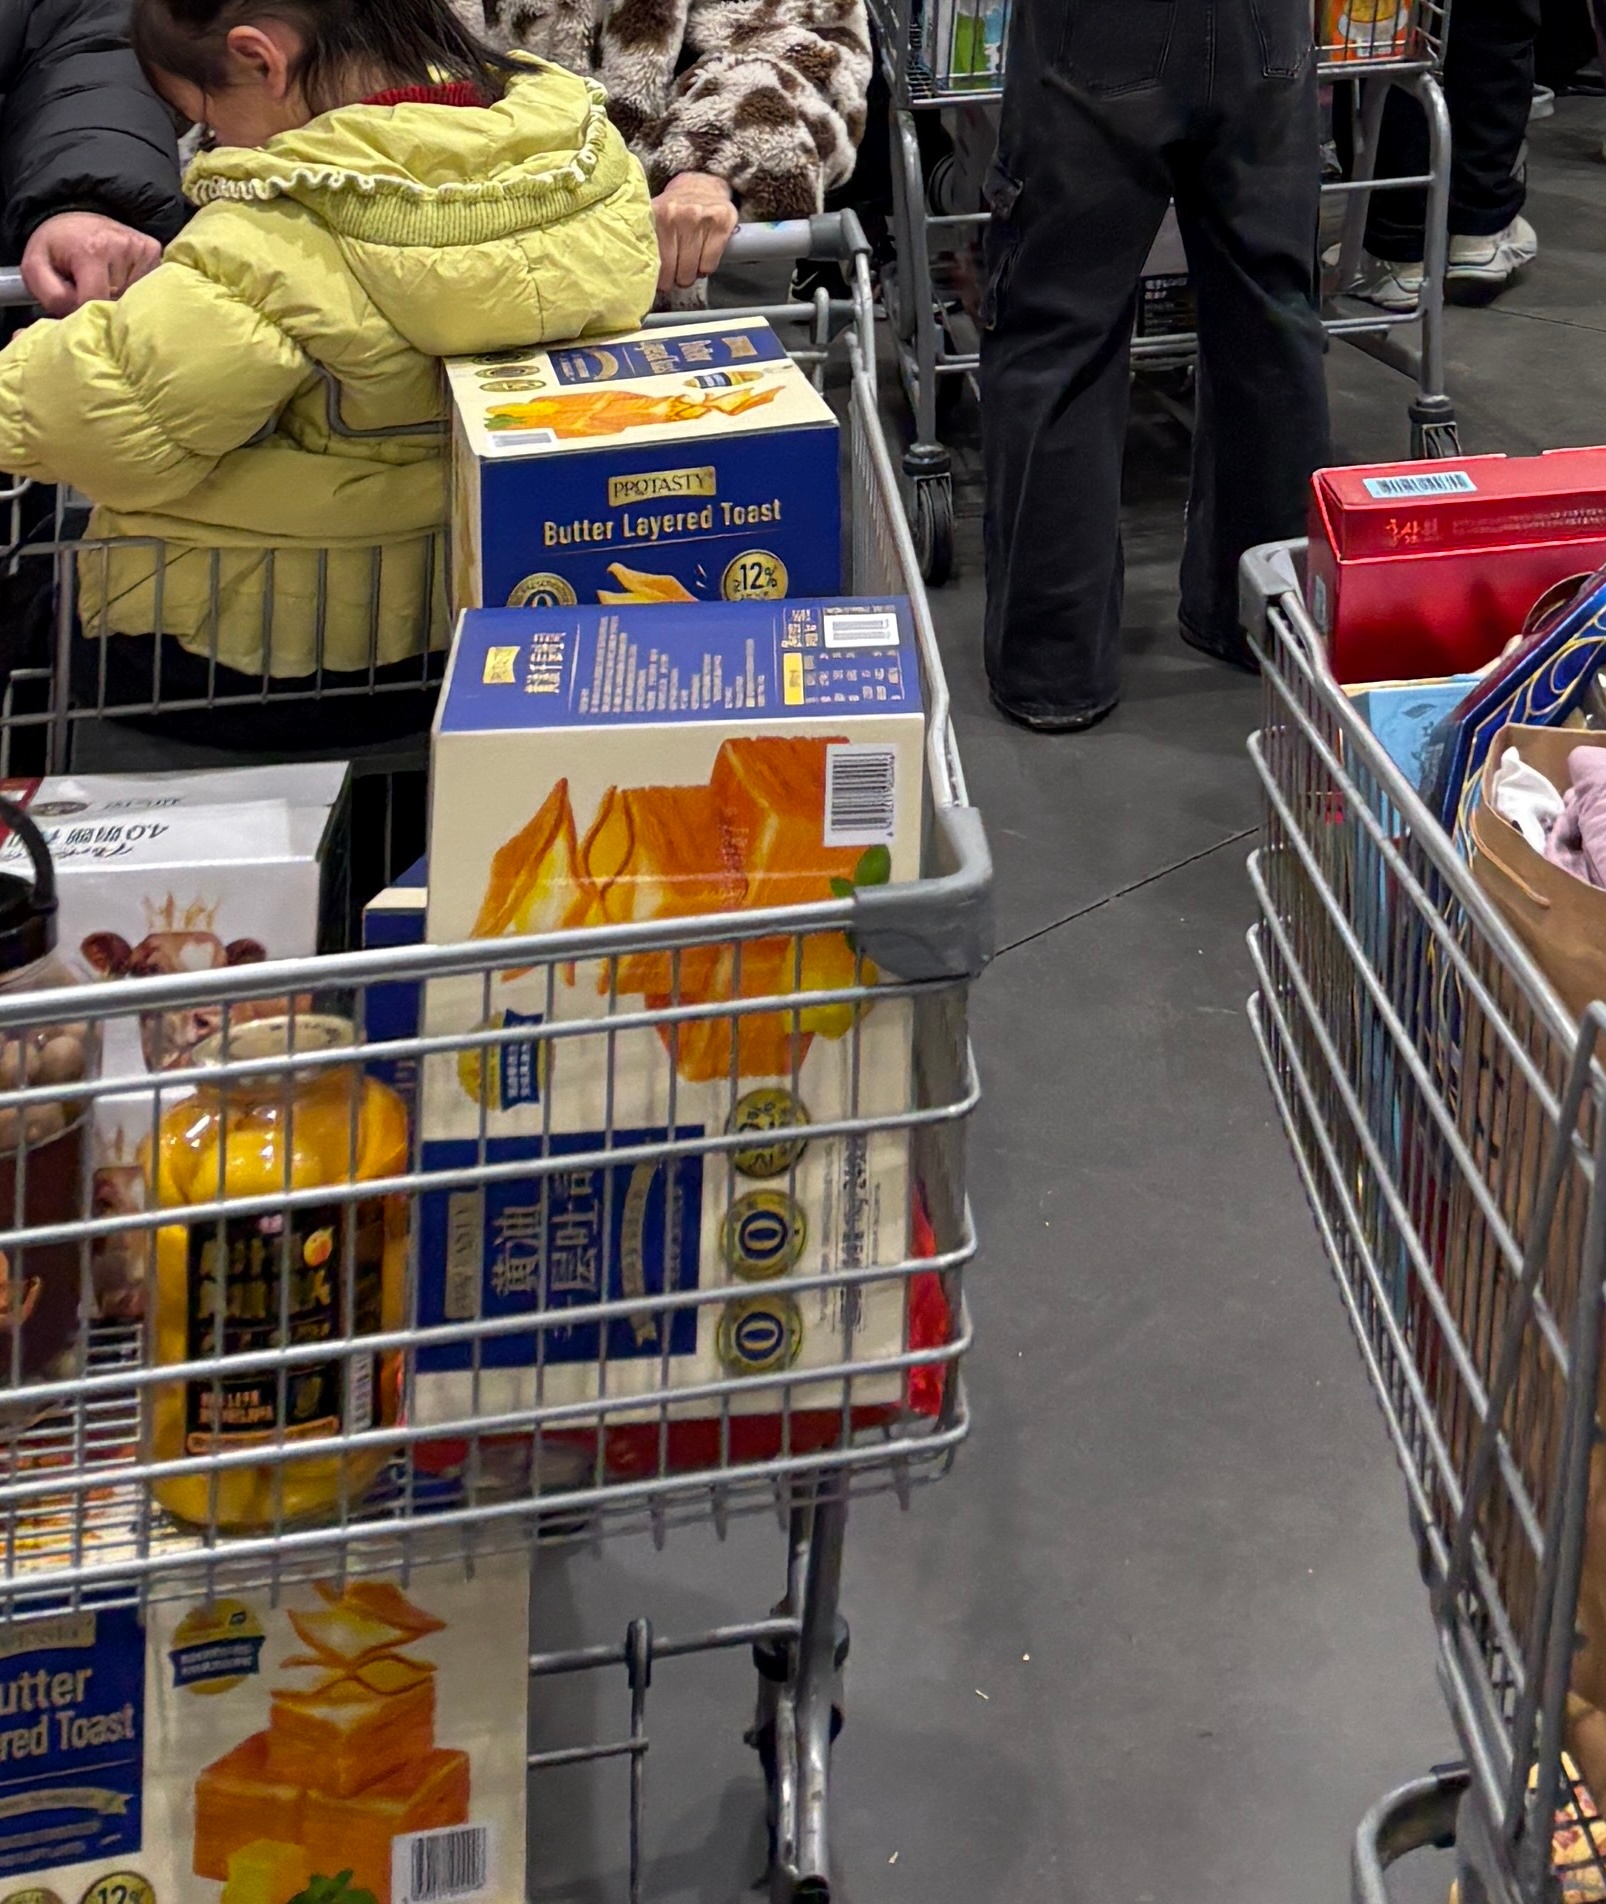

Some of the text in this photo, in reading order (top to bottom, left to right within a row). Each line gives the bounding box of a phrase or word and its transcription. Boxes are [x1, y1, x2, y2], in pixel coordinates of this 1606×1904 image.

[544, 498, 781, 547] Butter Layered Toast
[55, 1703, 136, 1752] Toast
